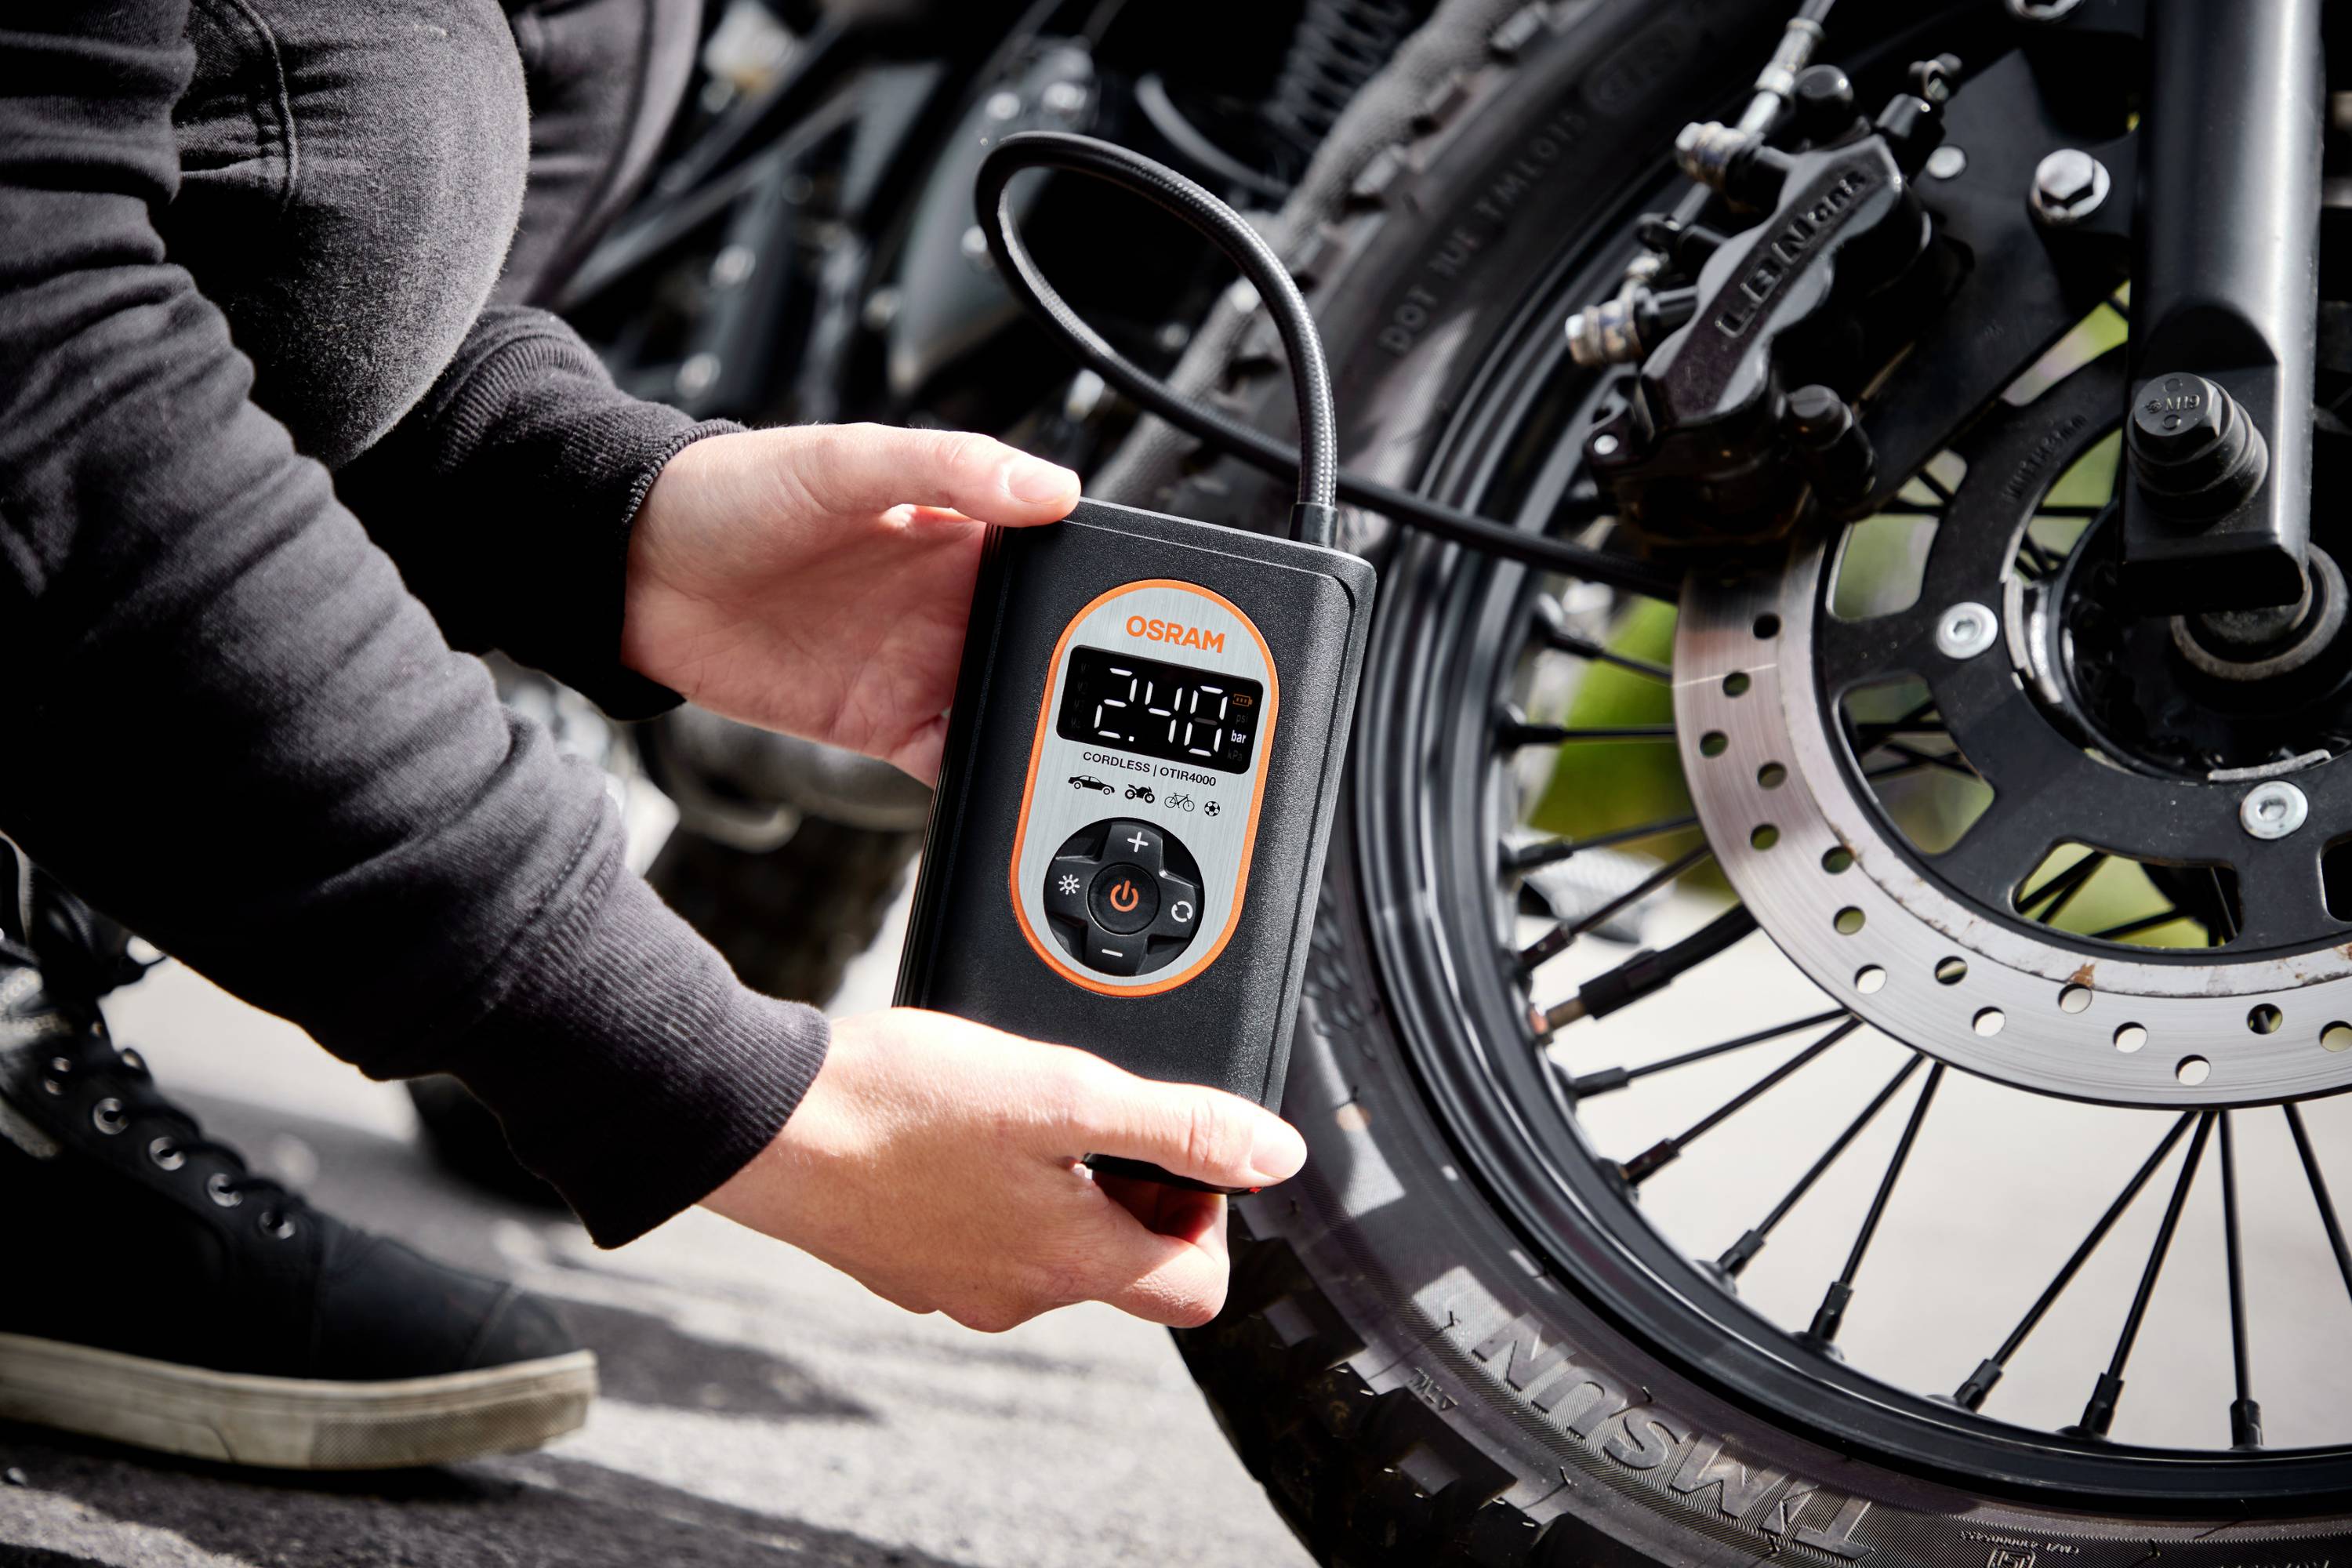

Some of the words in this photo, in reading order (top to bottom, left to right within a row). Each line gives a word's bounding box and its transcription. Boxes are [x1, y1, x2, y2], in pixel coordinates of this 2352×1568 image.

[1126, 615, 1225, 653] OSRAM
[1094, 667, 1229, 757] 2.40
[1230, 729, 1247, 744] bar
[1083, 751, 1151, 773] CORDLESS
[1160, 767, 1217, 786] OTIR4000
[1472, 1312, 1875, 1559] TIMSUN
